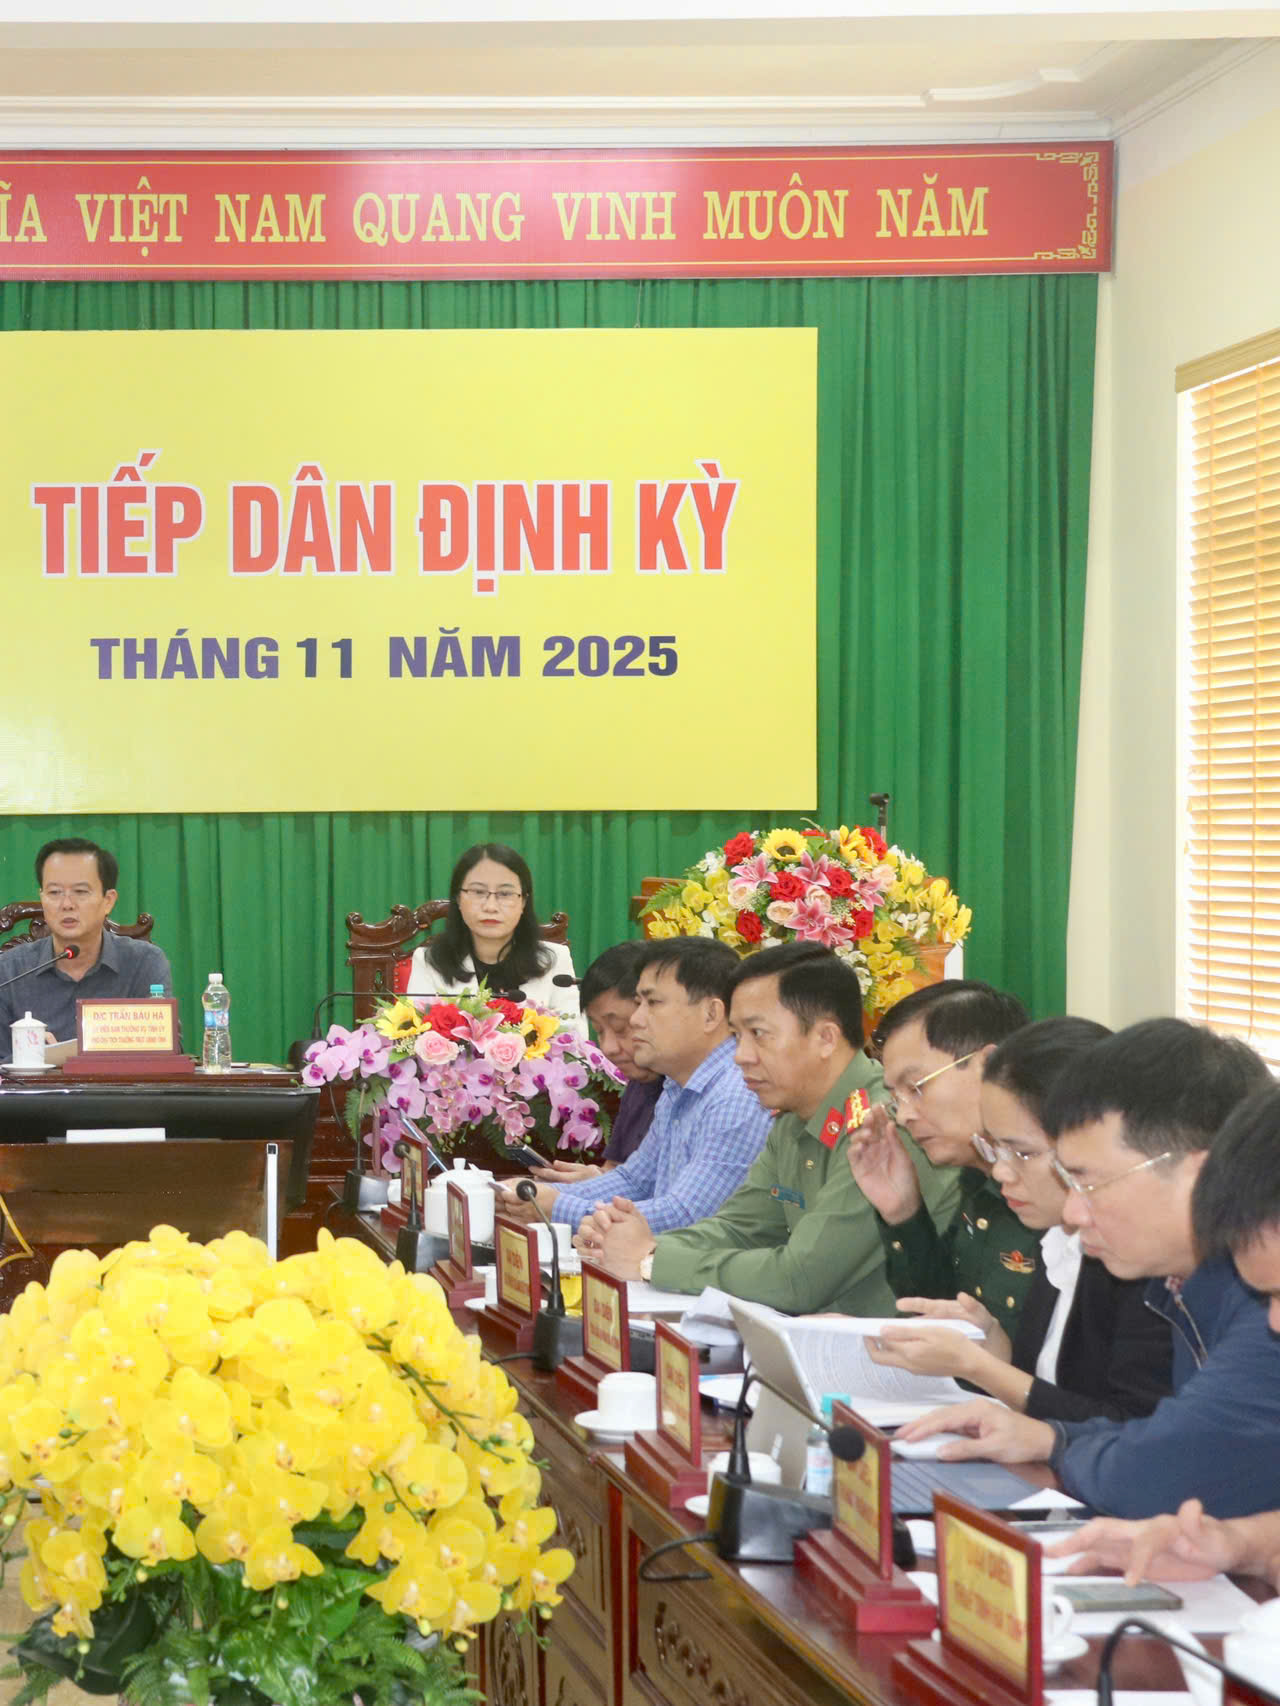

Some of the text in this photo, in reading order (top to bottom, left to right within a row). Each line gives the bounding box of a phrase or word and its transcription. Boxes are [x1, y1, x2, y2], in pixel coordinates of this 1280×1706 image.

[76, 177, 188, 257] VIỆT
[216, 193, 327, 243] NAM
[354, 191, 525, 246] QUANG
[552, 191, 677, 241] VINH
[704, 173, 849, 240] MUÔN
[876, 174, 989, 238] NĂM
[33, 451, 738, 594] TIẾP DÂN ĐỊNH KỲ
[90, 627, 678, 679] THÁNG 11 NĂM 2025
